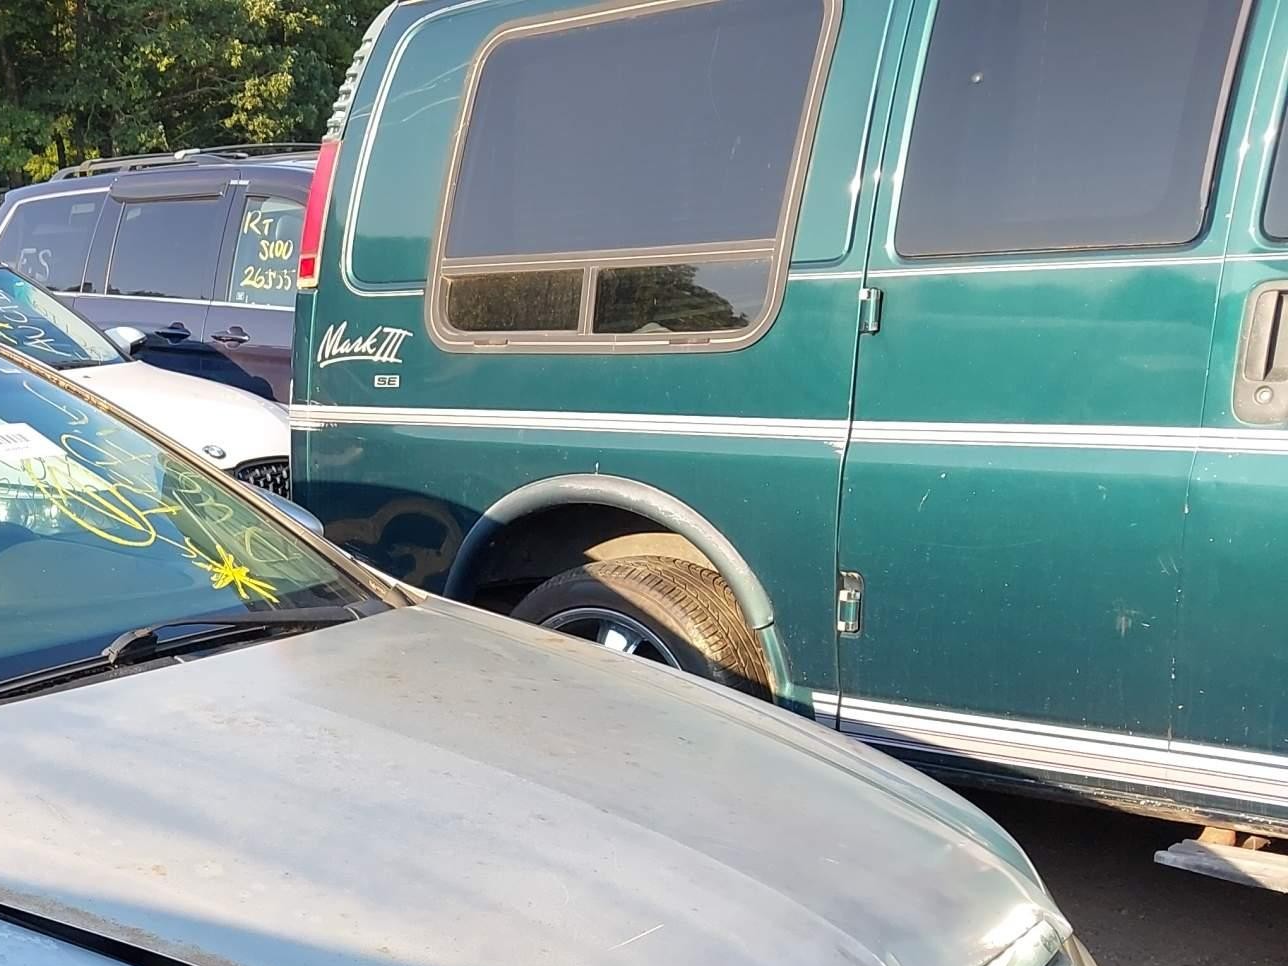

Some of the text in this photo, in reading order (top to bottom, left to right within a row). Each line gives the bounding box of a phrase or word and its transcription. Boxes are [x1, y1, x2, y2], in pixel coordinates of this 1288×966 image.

[243, 209, 274, 237] RT
[316, 320, 414, 363] Mark III
[375, 375, 399, 388] SE
